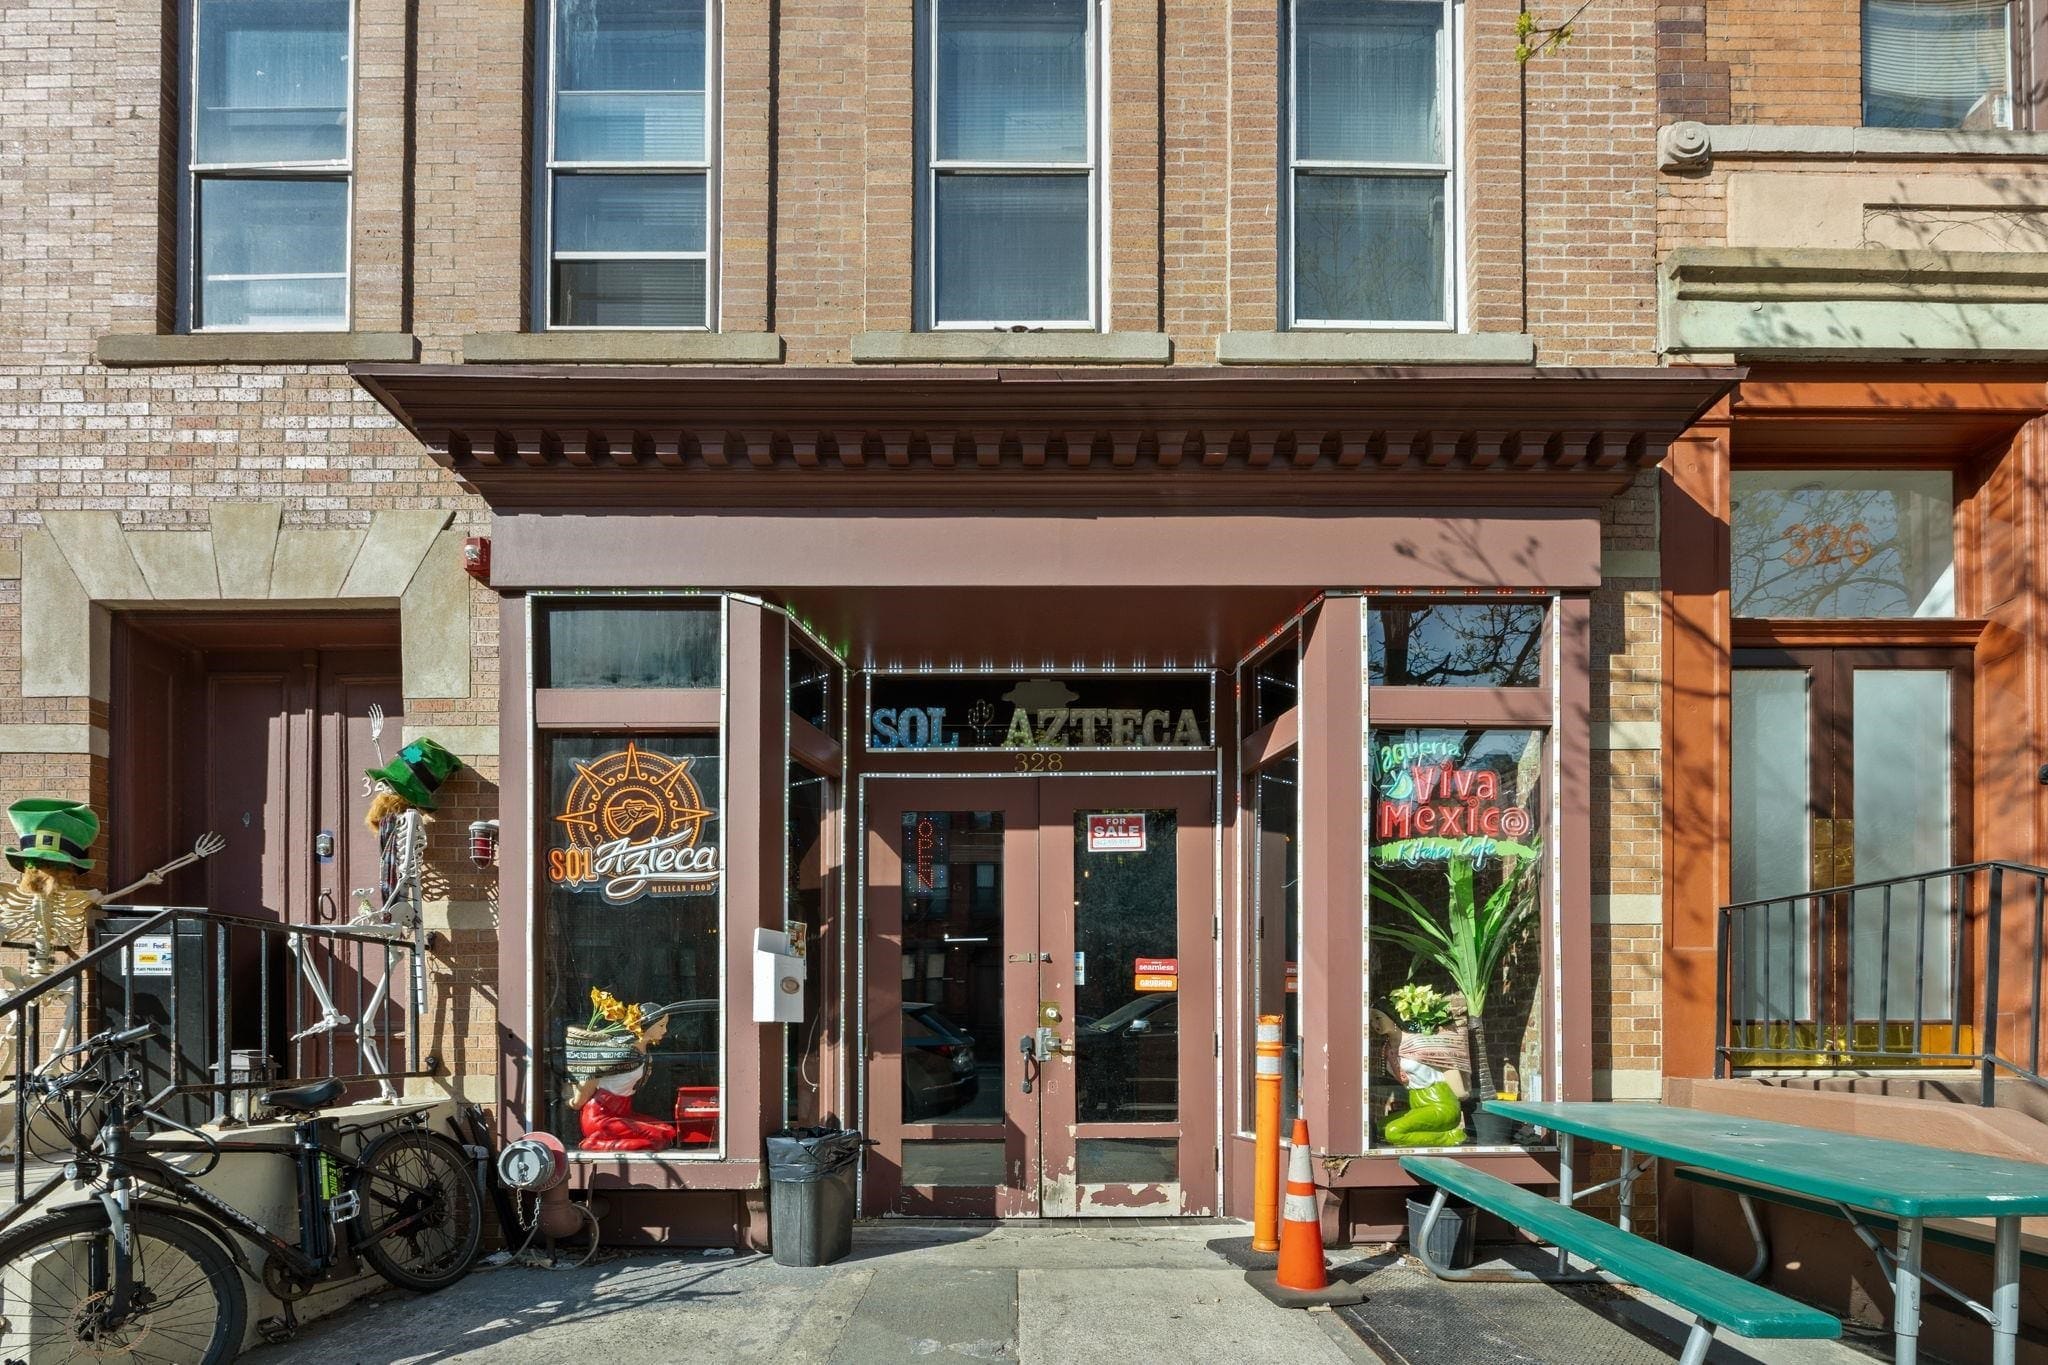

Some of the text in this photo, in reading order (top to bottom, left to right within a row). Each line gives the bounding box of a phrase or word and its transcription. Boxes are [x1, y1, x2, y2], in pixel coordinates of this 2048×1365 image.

[1781, 523, 1873, 567] 326
[872, 707, 1205, 748] SOL AZTECA
[1014, 753, 1064, 772] 328
[1412, 761, 1498, 804] Viva
[1094, 826, 1140, 838] SALE
[1381, 796, 1530, 838] Mexico
[550, 829, 719, 898] SOL Azteca
[918, 821, 933, 889] OPEN
[1398, 841, 1453, 865] Kitchen
[651, 884, 712, 893] MEXICAN FOOD
[1139, 963, 1174, 971] seamless
